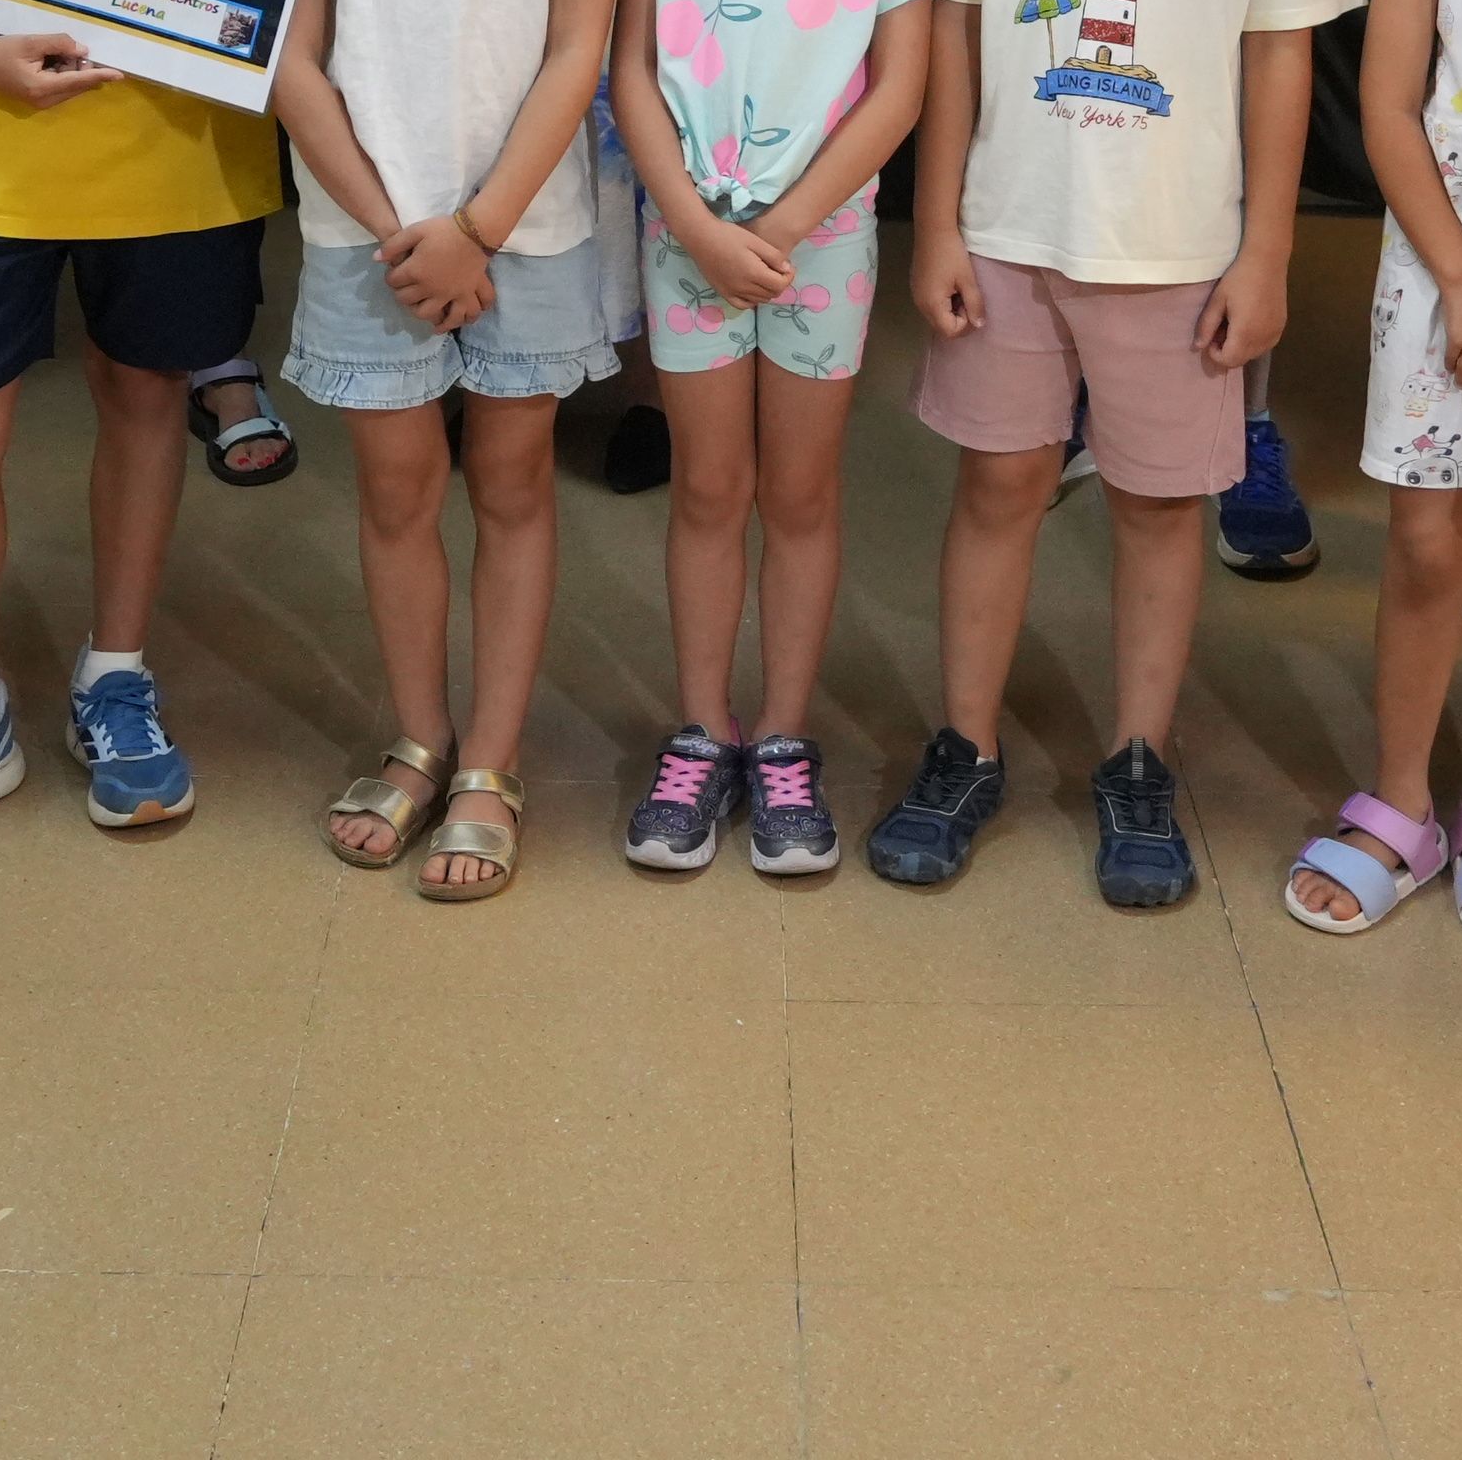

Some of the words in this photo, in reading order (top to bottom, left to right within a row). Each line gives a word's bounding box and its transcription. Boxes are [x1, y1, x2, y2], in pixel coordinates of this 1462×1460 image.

[1057, 72, 1091, 91] LONG
[1096, 77, 1153, 102] ISLAND
[1047, 100, 1077, 120] New
[1079, 105, 1127, 129] York
[1131, 115, 1149, 130] 75
